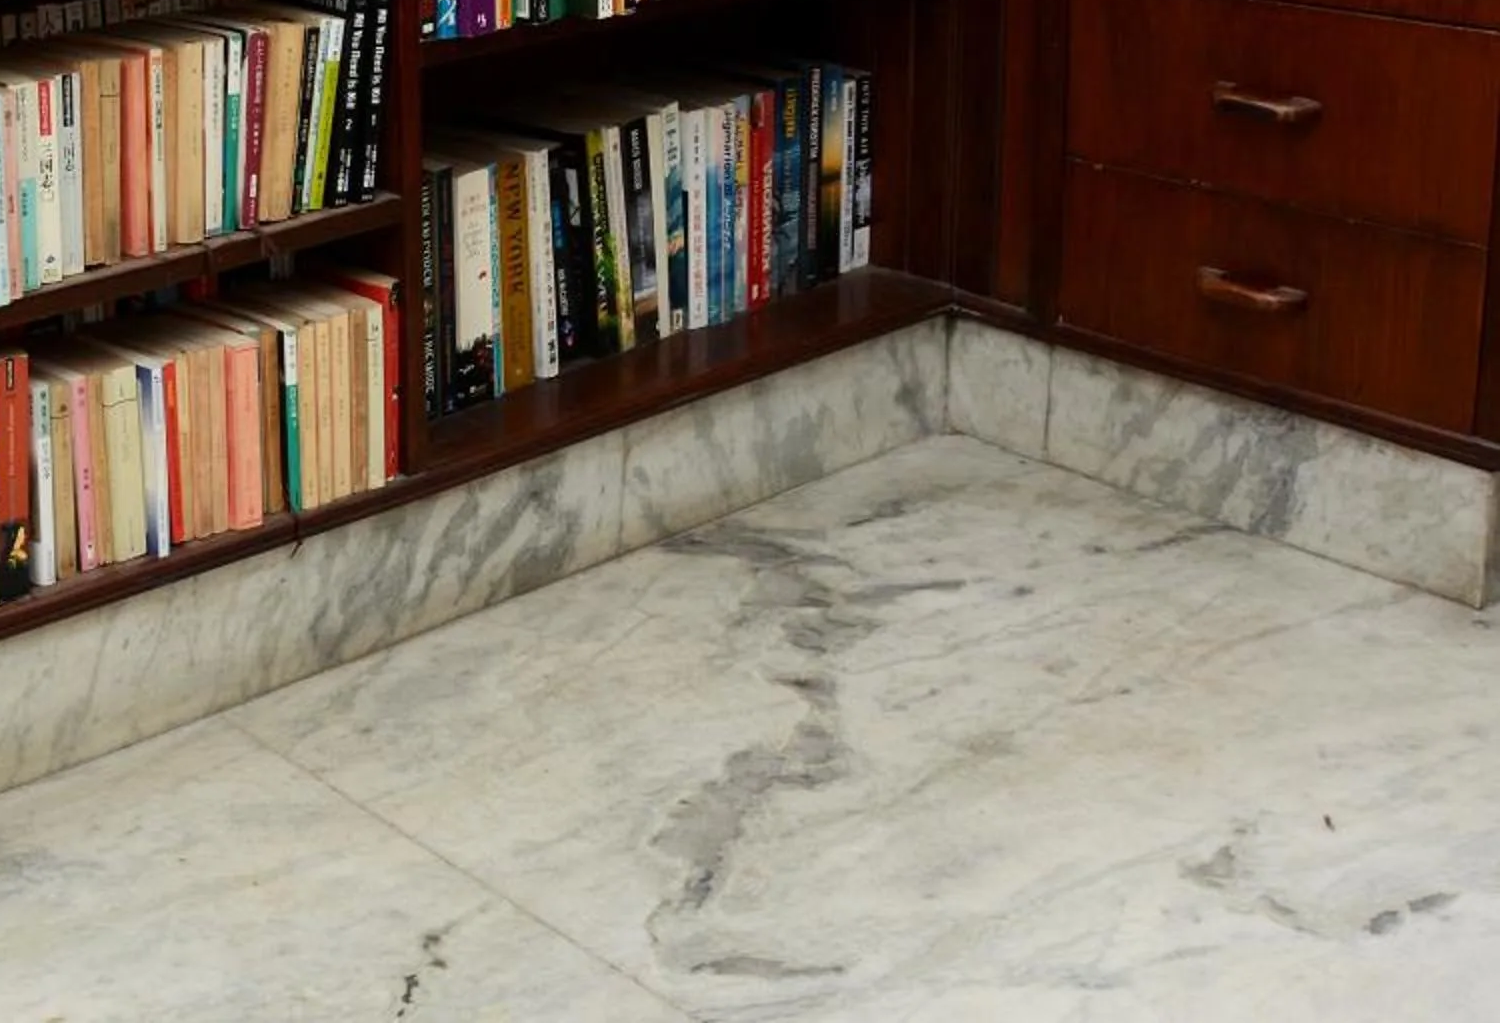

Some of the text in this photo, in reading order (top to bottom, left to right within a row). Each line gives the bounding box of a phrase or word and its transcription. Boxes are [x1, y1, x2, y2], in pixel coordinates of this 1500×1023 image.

[351, 30, 365, 49] You
[374, 26, 387, 45] You
[503, 163, 525, 295] NEW YORK
